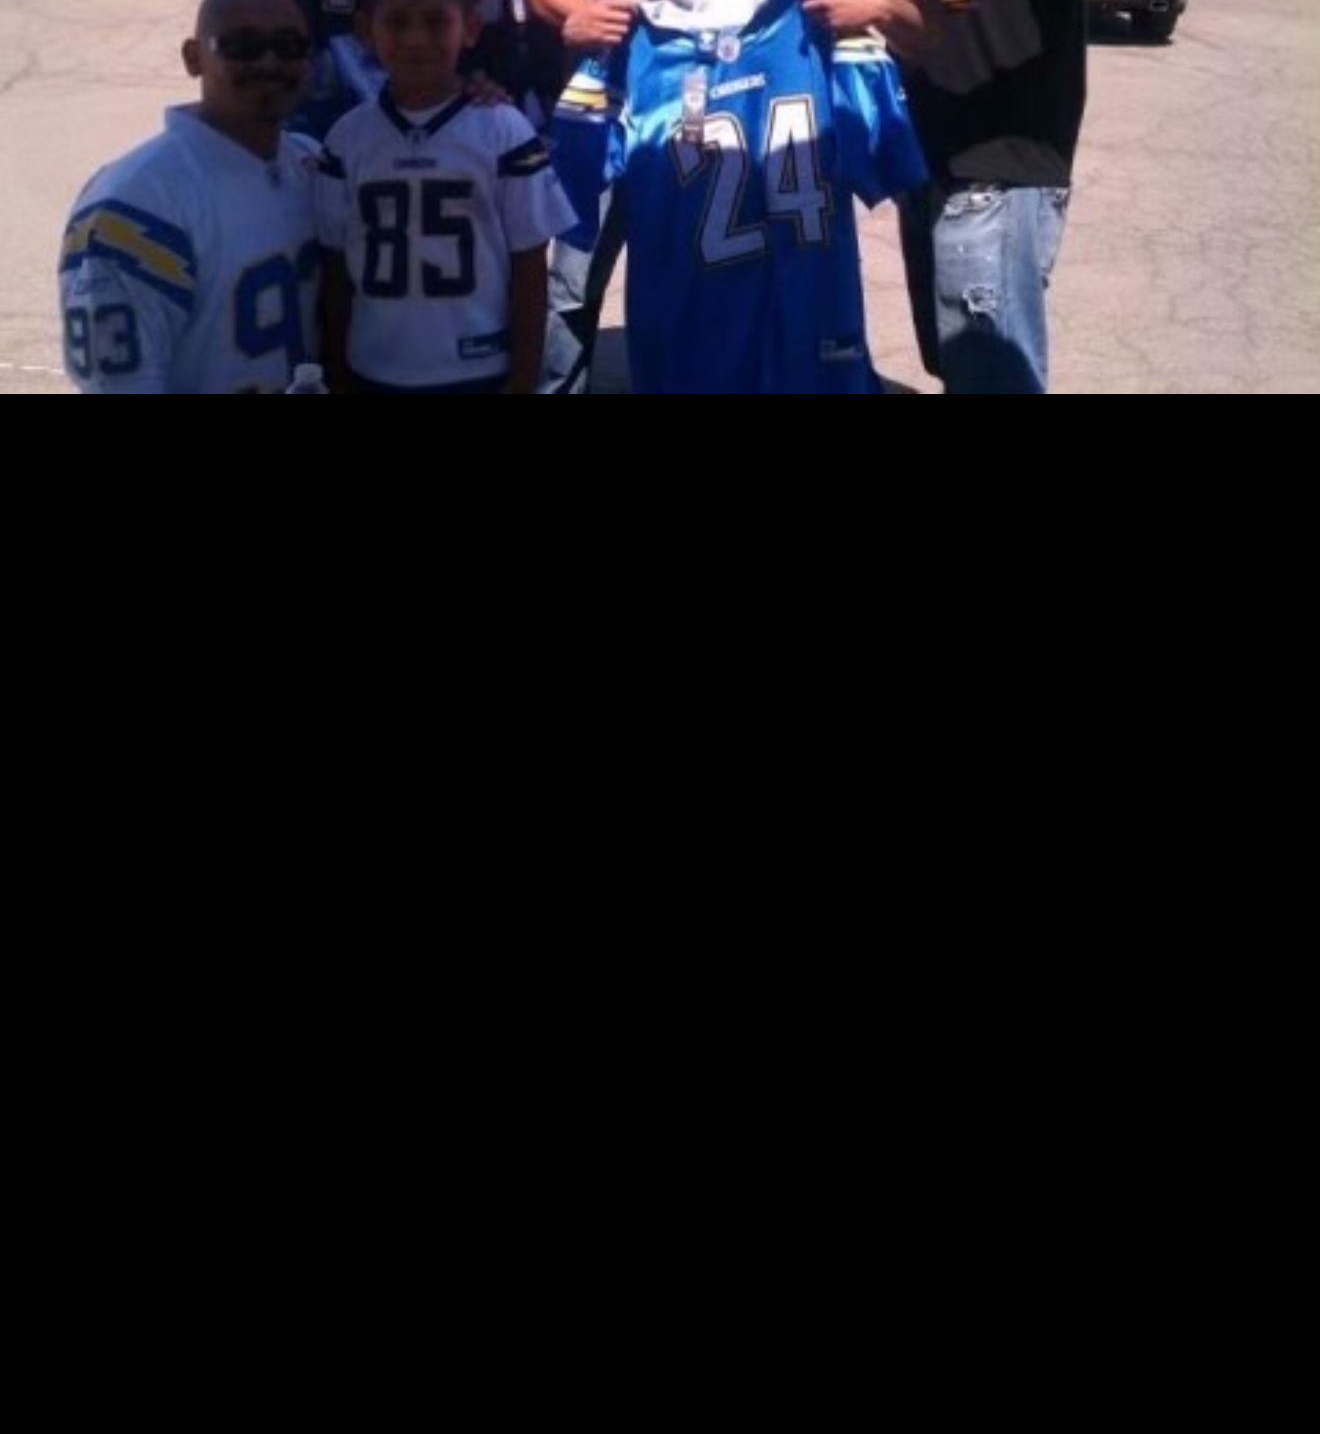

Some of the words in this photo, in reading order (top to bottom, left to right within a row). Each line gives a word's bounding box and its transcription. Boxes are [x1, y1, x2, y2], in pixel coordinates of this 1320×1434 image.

[358, 178, 476, 299] 85
[669, 94, 831, 268] 24
[64, 304, 142, 379] 93
[233, 246, 320, 380] 9
